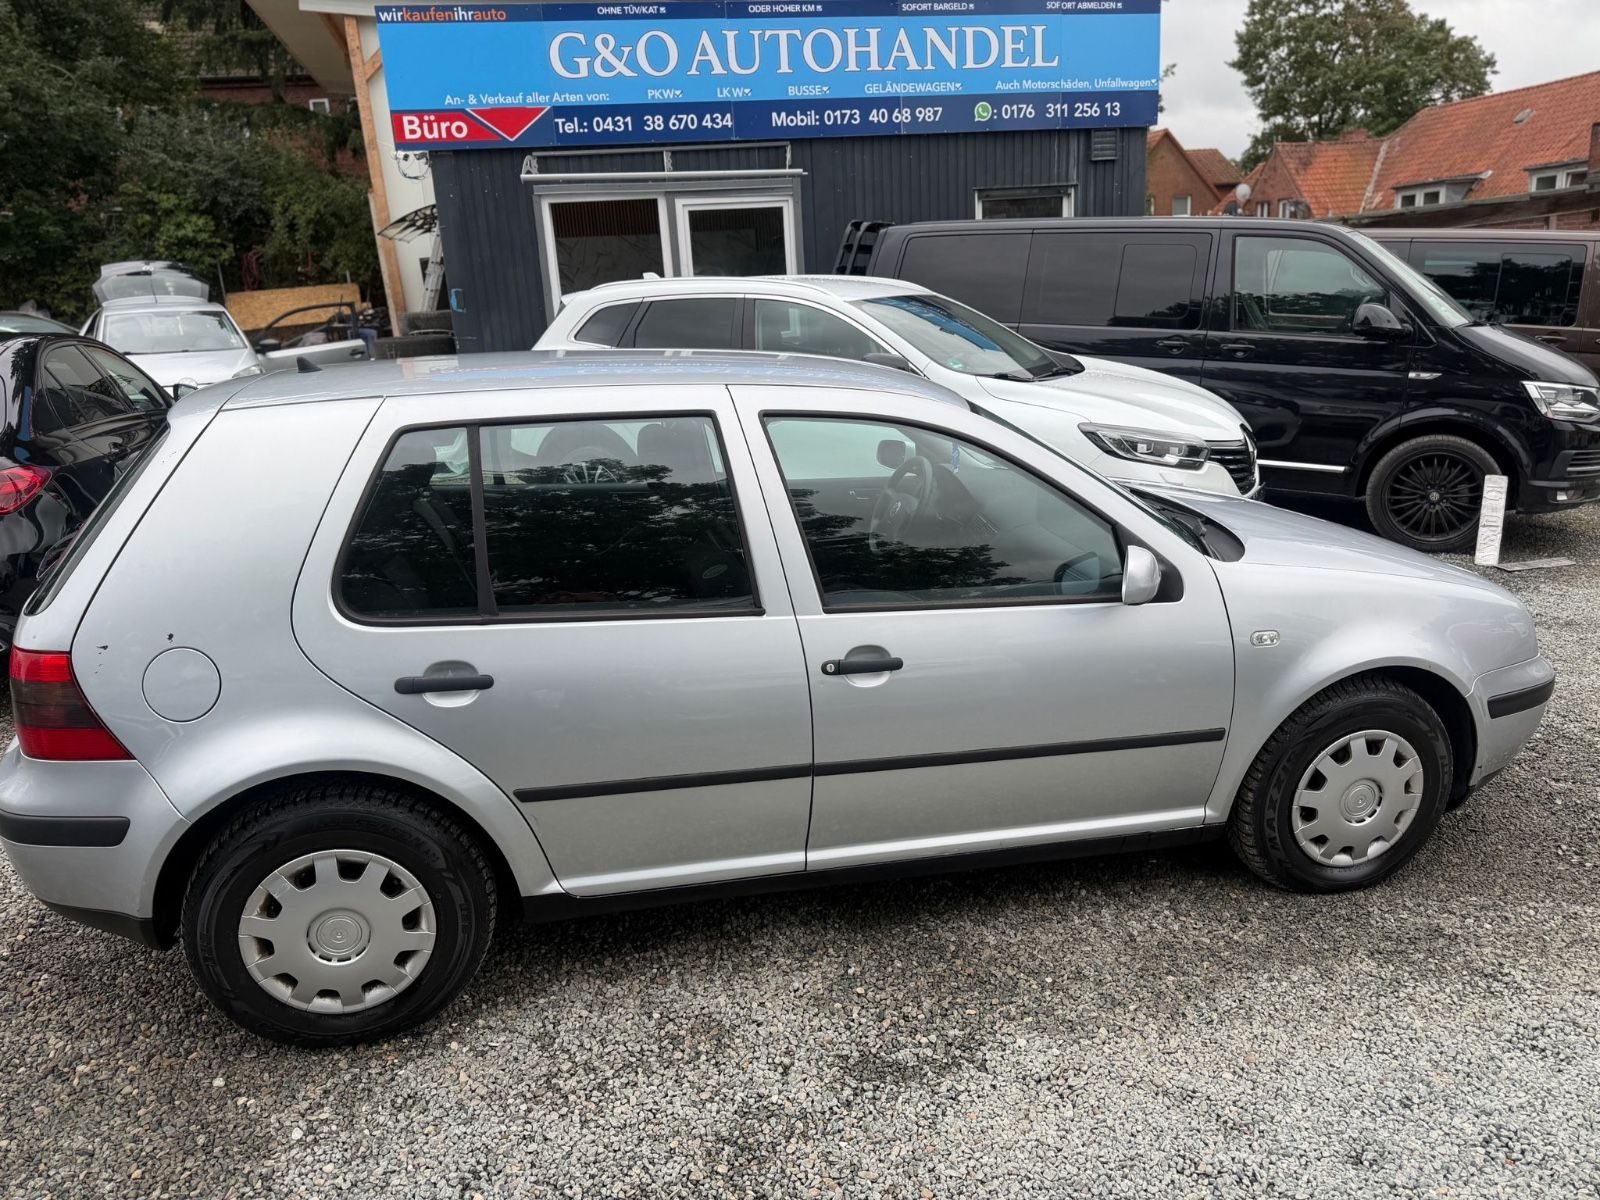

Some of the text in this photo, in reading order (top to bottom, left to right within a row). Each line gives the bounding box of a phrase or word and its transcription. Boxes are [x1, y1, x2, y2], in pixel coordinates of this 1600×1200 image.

[597, 5, 659, 15] OHNE TÜV/KAT
[748, 3, 815, 13] ODER HOHER KM
[902, 2, 967, 11] SOFORT BARGELD
[1077, 1, 1116, 9] ABMELDEN
[379, 6, 507, 22] wirkaufenihrauto
[549, 24, 1060, 79] G&O AUTOHANDEL
[864, 81, 956, 94] GELÄNDEWAGEN
[995, 77, 1150, 90] Auch Motorschäden, Unfallwagen
[647, 89, 674, 99] PKW
[788, 85, 822, 96] BUSSE
[444, 91, 610, 105] An- & Verkauf aller Arten von:
[771, 107, 943, 127] Mobil: 0173 40 68 987
[1001, 104, 1035, 119] 0176
[1045, 103, 1069, 118] 311
[1074, 102, 1101, 118] 256
[1104, 102, 1121, 117] 13
[402, 114, 468, 140] Büro
[554, 113, 733, 133] Tel.: 0431 38 670 434
